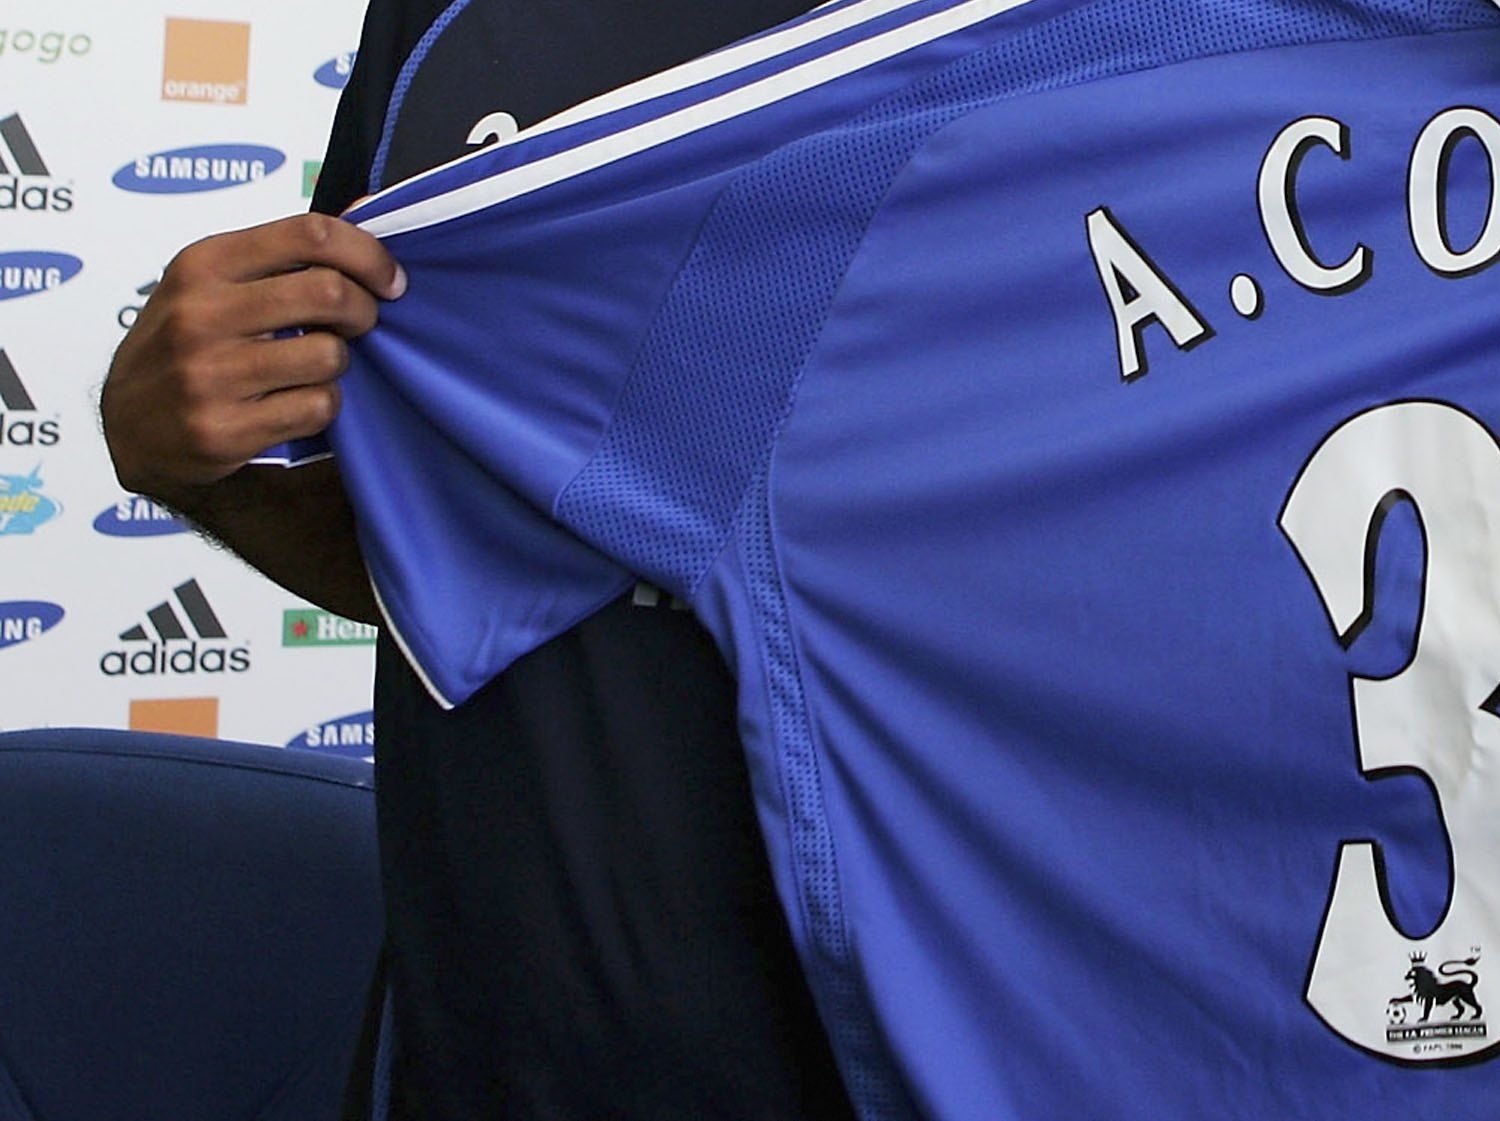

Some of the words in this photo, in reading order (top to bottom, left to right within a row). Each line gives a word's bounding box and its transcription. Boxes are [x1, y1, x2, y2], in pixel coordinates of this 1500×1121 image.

[166, 80, 241, 102] orange
[134, 154, 266, 182] SAMSUNG
[100, 640, 250, 676] adidas
